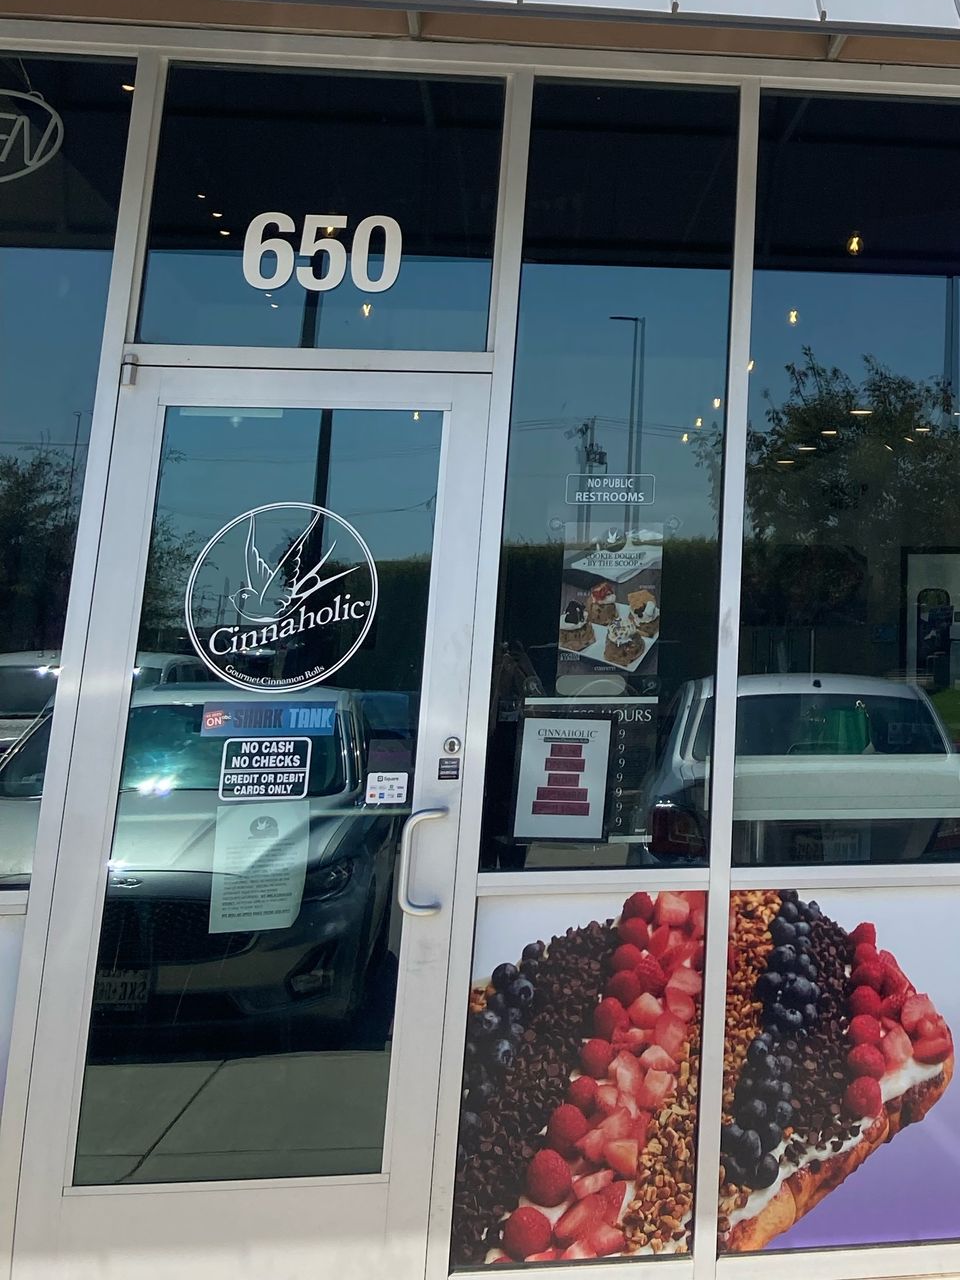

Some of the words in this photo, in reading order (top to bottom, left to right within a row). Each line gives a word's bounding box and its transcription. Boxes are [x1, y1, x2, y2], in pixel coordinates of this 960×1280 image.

[242, 211, 403, 293] 650
[587, 478, 601, 488] NO
[602, 478, 634, 488] PUBLIC
[575, 491, 645, 502] RESTROOMS
[586, 552, 613, 560] COOKIE
[208, 593, 367, 656] Cinnaholic
[225, 664, 261, 684] Gourmet
[260, 673, 305, 686] Cinnamon
[304, 665, 325, 679] Rolls
[206, 716, 223, 728] ON
[233, 708, 284, 729] SHARK
[289, 707, 334, 729] TANK
[537, 728, 598, 739] CINNAHOLIC
[241, 742, 259, 754] NO
[261, 741, 295, 753] CASH
[231, 756, 250, 768] NO
[251, 755, 301, 767] CHECKS
[224, 774, 259, 784] CREDIT
[261, 774, 274, 784] OR
[276, 773, 305, 783] DEBIT
[233, 785, 265, 795] CARDS
[267, 784, 293, 794] ONLY
